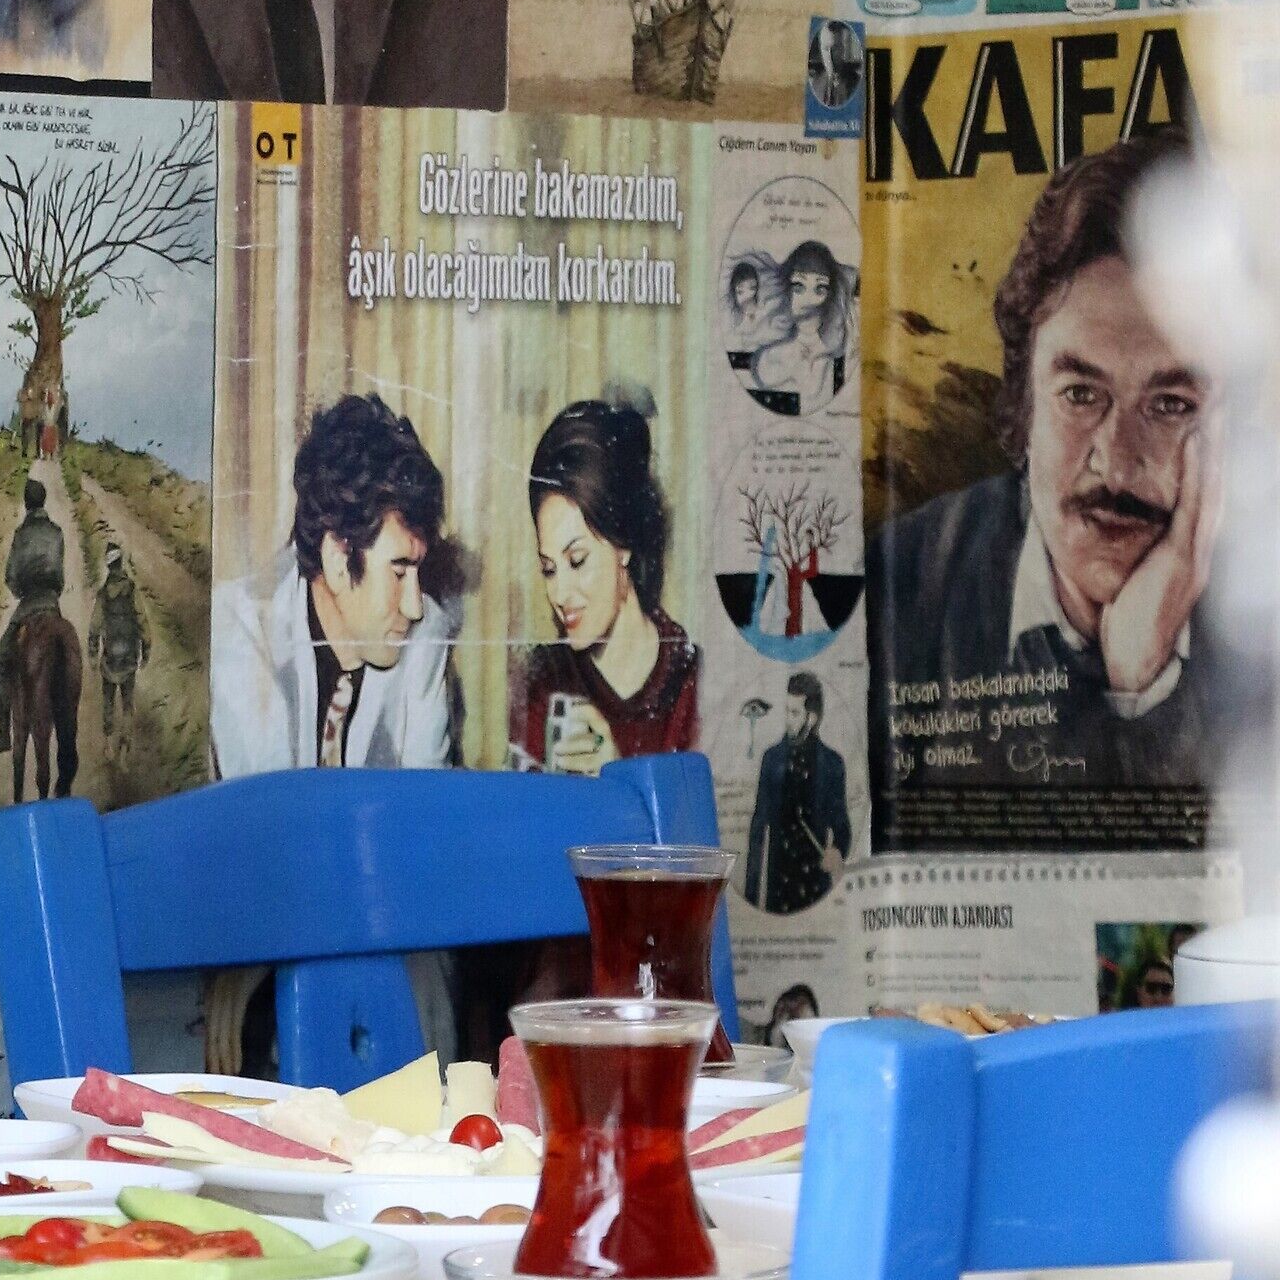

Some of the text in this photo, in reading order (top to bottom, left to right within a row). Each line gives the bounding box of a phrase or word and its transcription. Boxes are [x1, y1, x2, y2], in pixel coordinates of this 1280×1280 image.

[420, 152, 527, 218] Gözlerine
[534, 158, 683, 230] bakamazdım,
[348, 234, 682, 314] âşık olacağımdan korkardım.
